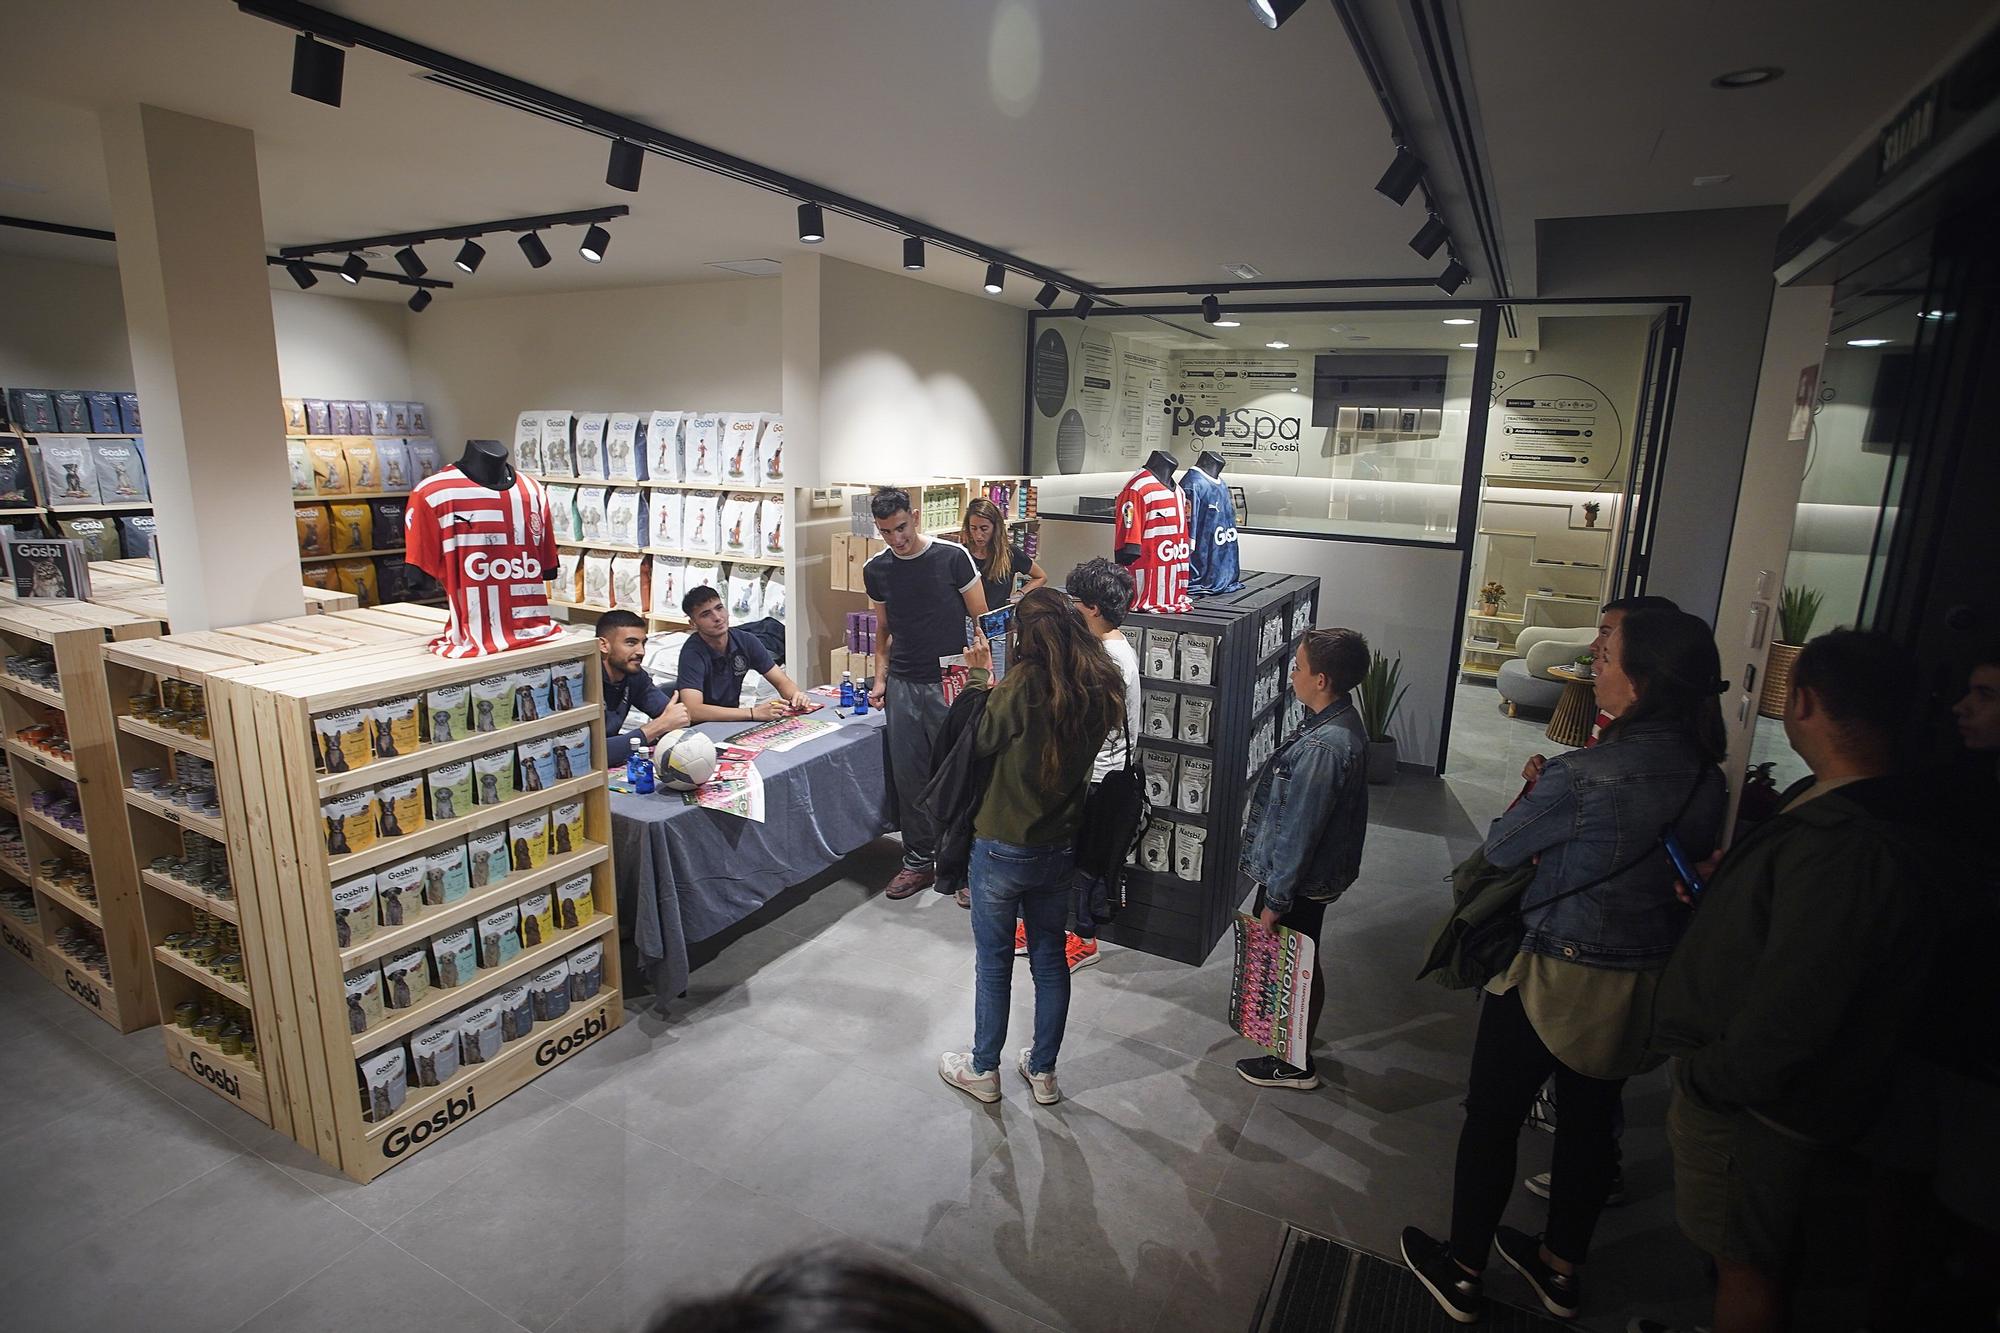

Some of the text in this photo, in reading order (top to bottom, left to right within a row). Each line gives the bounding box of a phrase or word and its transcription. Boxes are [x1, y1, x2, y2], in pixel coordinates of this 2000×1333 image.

[732, 422, 755, 431] Gosbi
[1172, 407, 1301, 450] PetSpa
[1270, 442, 1300, 452] Gosbi
[71, 519, 105, 531] Gosbi
[131, 517, 156, 527] Gos
[17, 544, 62, 558] Gosbi
[463, 551, 542, 582] Gosb
[1151, 634, 1173, 643] Natsbi
[1187, 640, 1209, 648] Natsbi
[1150, 694, 1171, 703] Natsbi
[1184, 760, 1210, 771] Natsbi
[1178, 827, 1201, 840] Natsbi
[388, 865, 419, 880] Gosbits
[335, 884, 369, 901] Gosbits
[65, 968, 103, 1011] Gosbi
[1277, 934, 1297, 1053] GIRONA FC
[535, 1009, 608, 1067] Gosbi
[190, 1051, 242, 1100] Gosbi
[382, 1086, 477, 1159] Gosbi
